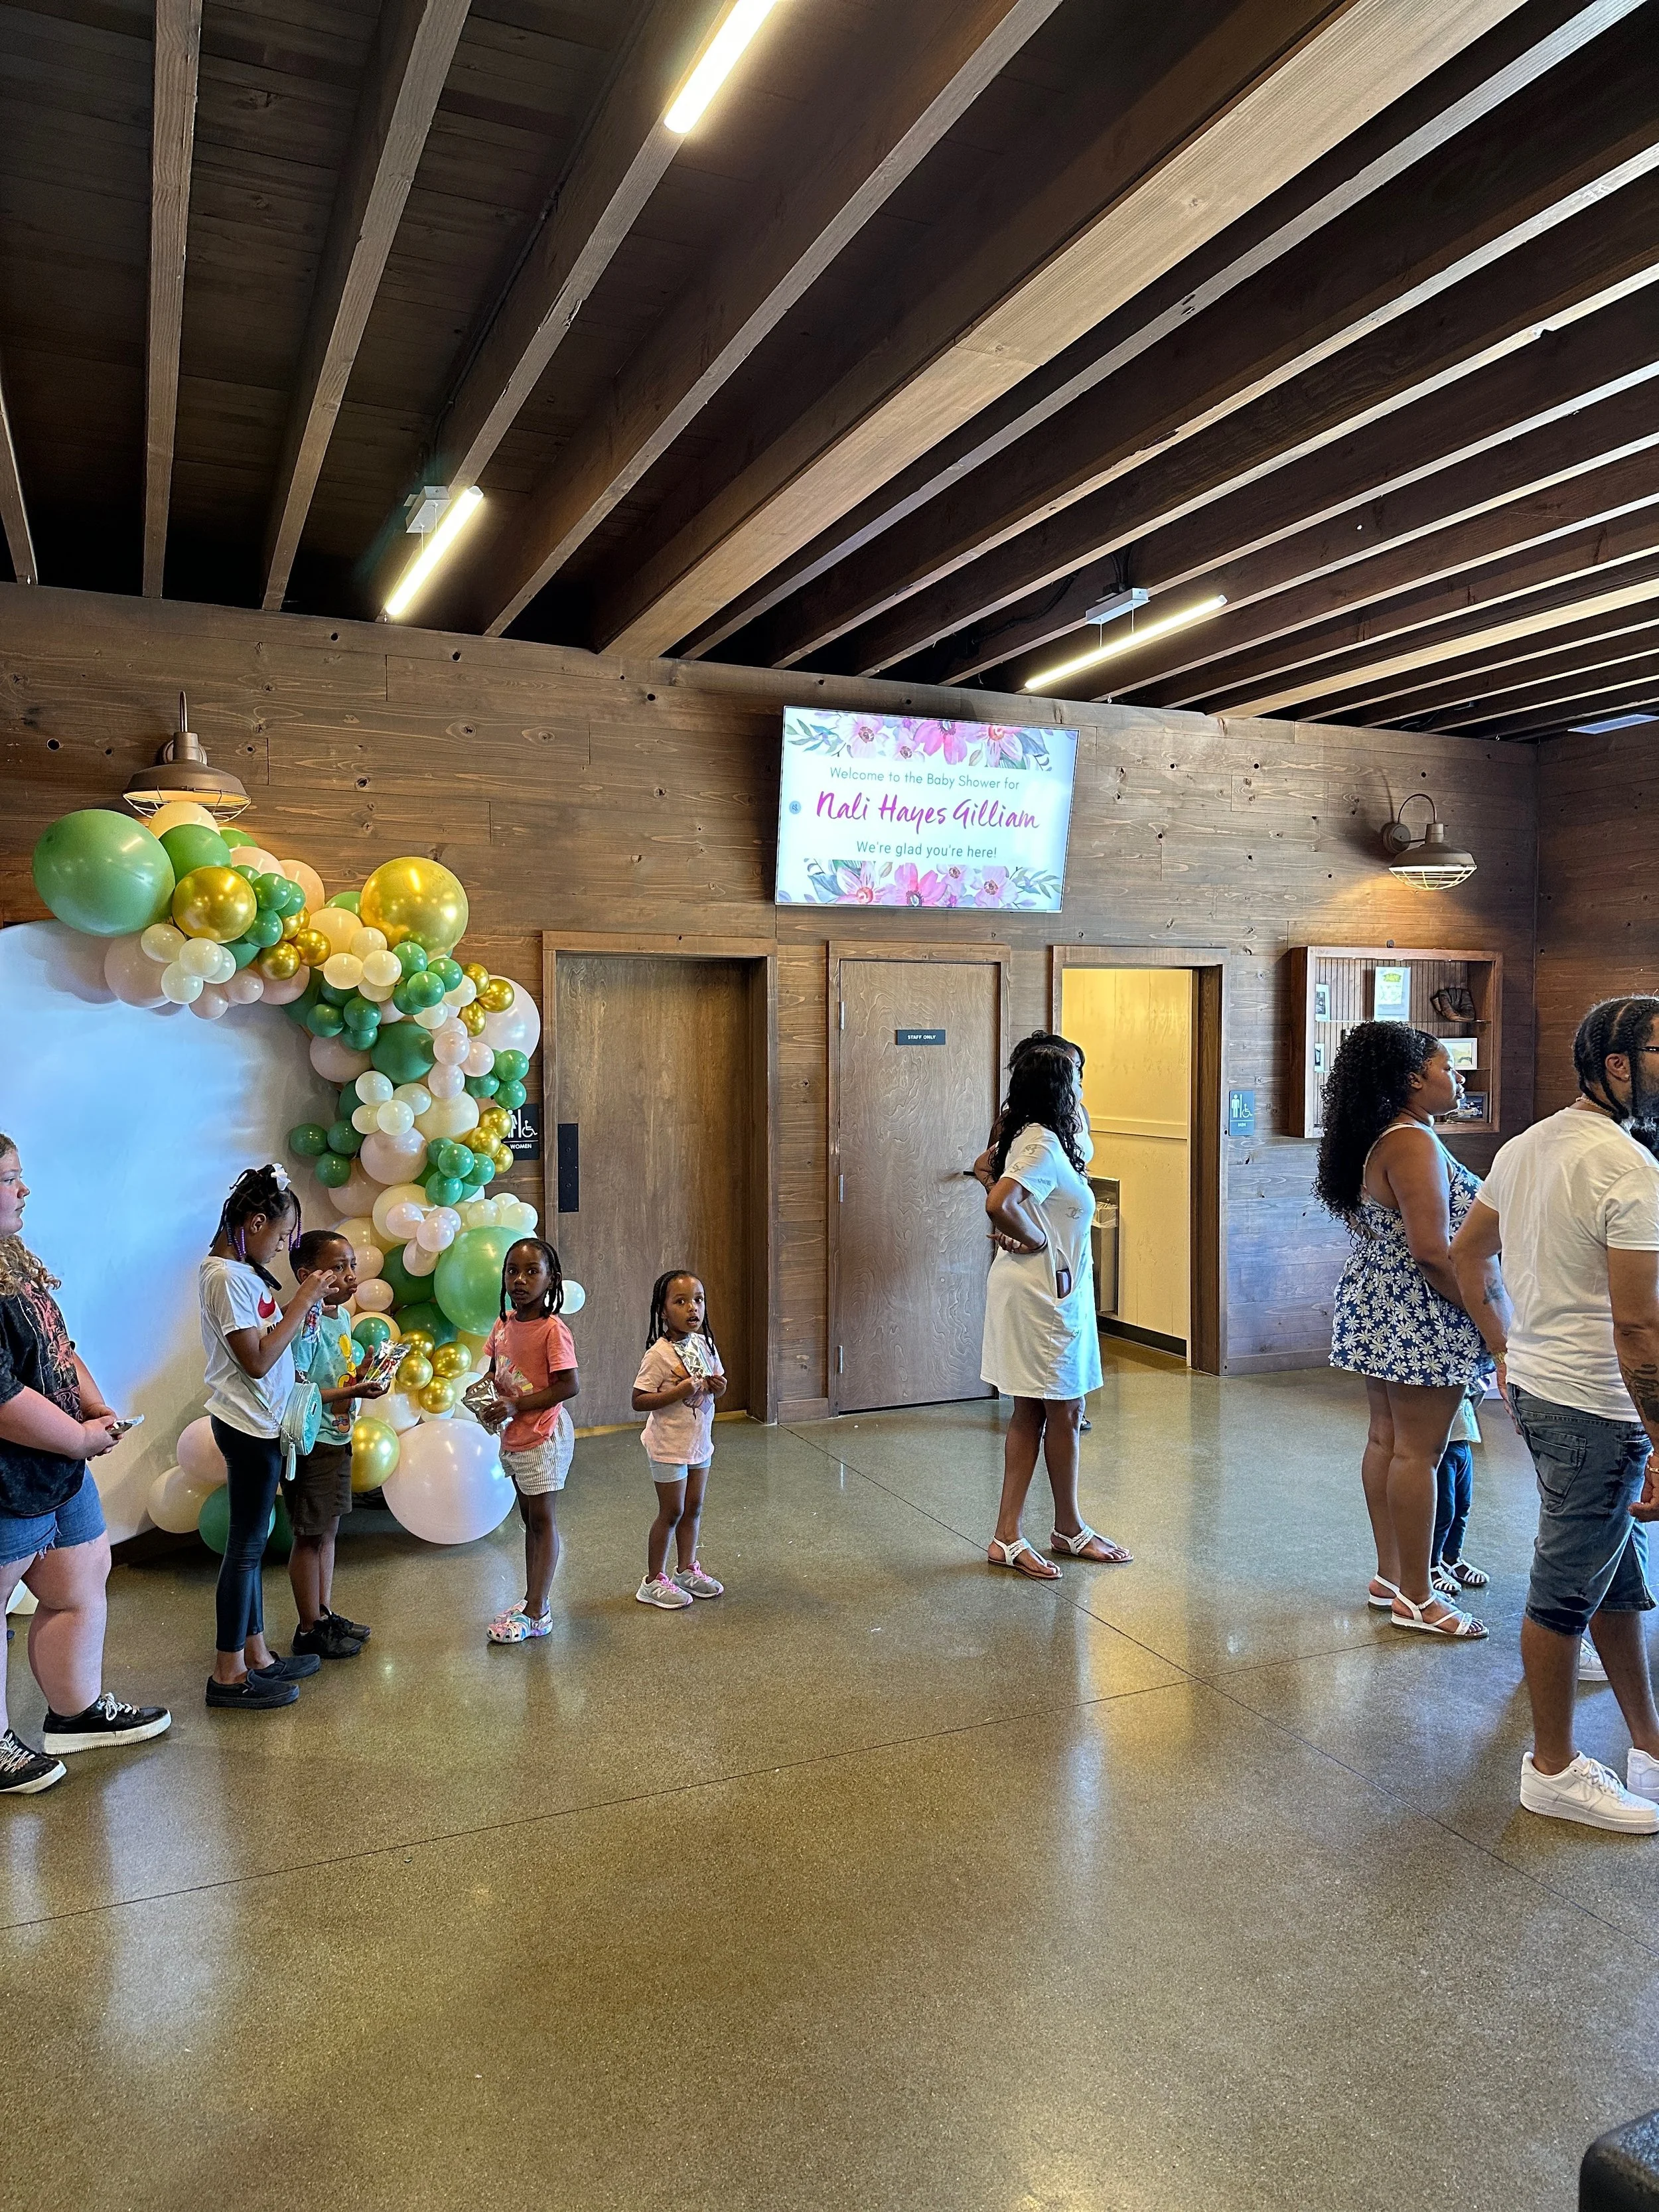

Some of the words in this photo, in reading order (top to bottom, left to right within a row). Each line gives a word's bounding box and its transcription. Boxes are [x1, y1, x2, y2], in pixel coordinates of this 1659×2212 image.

[830, 767, 885, 781] Welcome
[889, 771, 901, 782] to
[904, 771, 923, 784] the
[927, 773, 955, 790] Baby
[958, 774, 1001, 788] Shower
[1004, 776, 1020, 790] for
[816, 790, 871, 820] Nali
[878, 793, 948, 834] Hayes
[952, 798, 1041, 830] Gilliam
[857, 841, 891, 853] We're
[895, 842, 922, 857] glad
[926, 844, 963, 859] you're
[967, 846, 997, 858] here!
